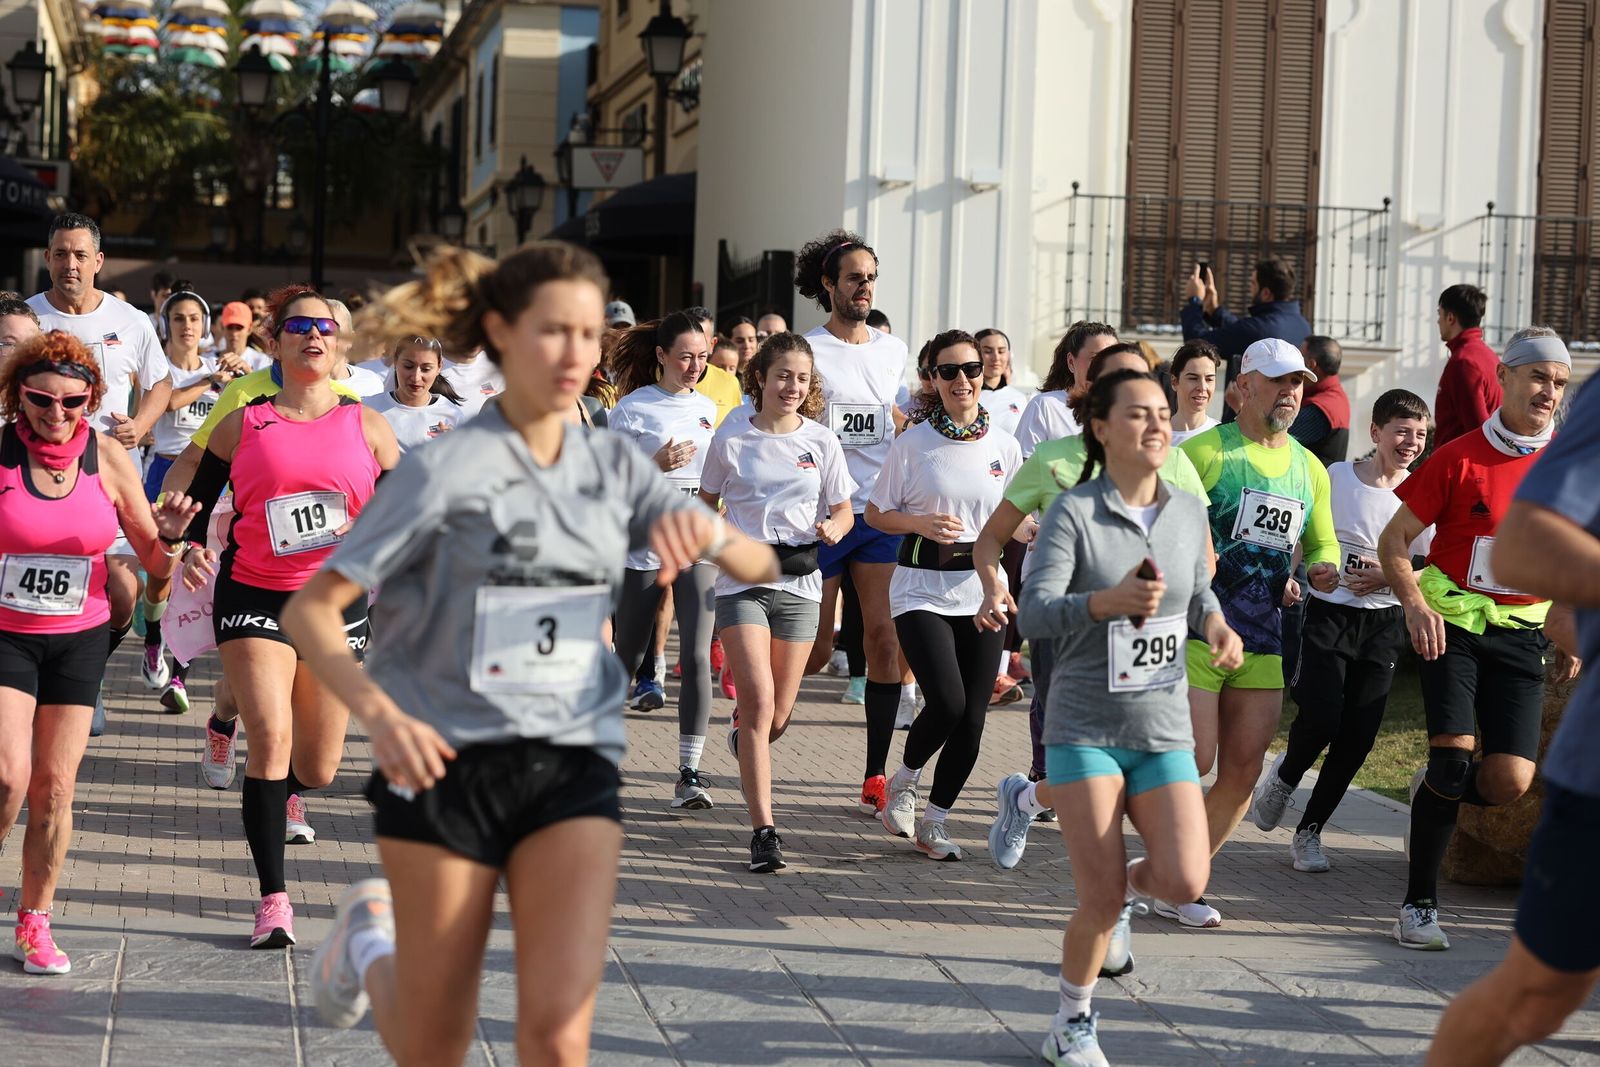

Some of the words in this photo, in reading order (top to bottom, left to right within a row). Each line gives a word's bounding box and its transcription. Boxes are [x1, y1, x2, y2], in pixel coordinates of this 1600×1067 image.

[843, 413, 875, 432] 204
[291, 503, 326, 533] 119
[1254, 504, 1292, 533] 239
[19, 567, 70, 595] 456
[220, 614, 280, 631] NIKE
[537, 616, 557, 656] 3
[346, 636, 366, 650] RO
[1132, 634, 1177, 668] 299
